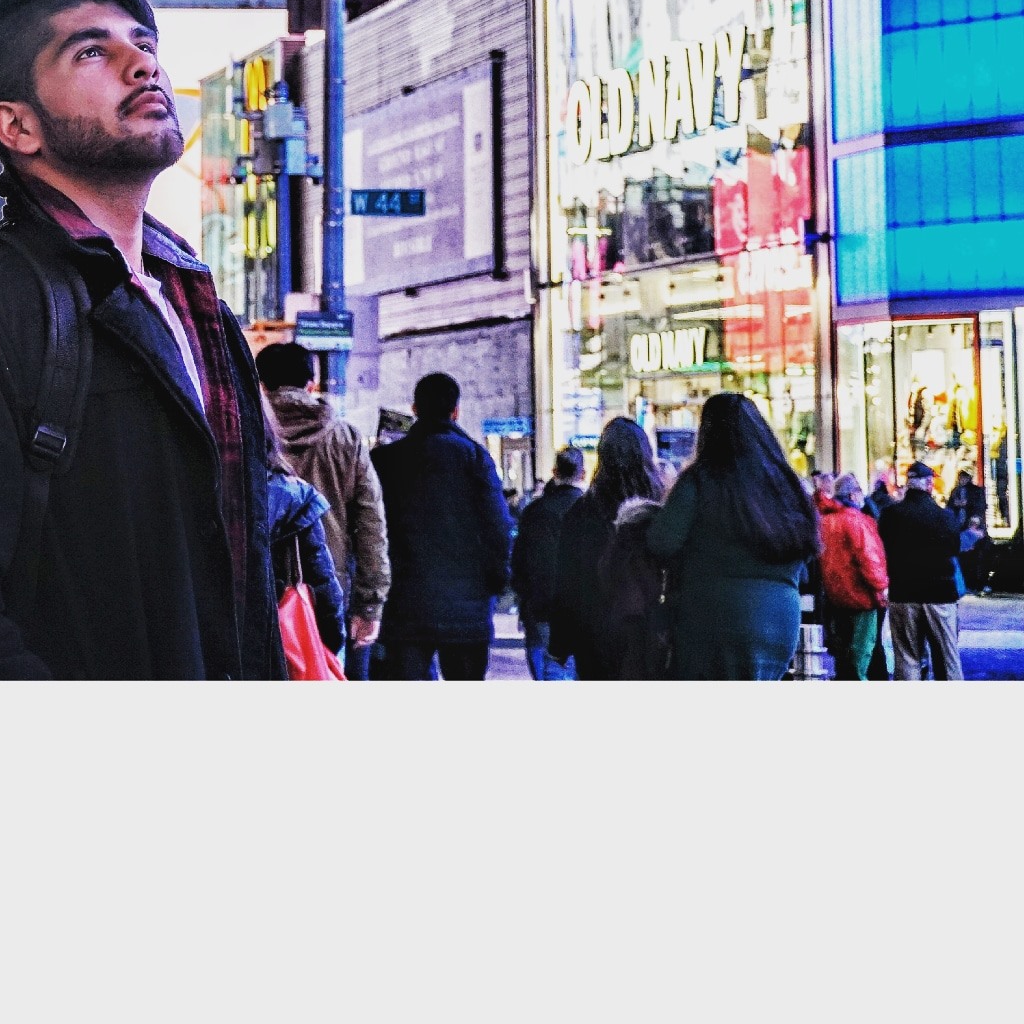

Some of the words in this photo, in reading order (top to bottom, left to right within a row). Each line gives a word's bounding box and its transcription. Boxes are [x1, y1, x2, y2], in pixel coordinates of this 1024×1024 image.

[565, 66, 635, 166] OLD
[637, 24, 747, 148] NAVY
[375, 192, 401, 214] 44
[630, 332, 661, 373] OLD
[660, 326, 706, 371] NAVY
